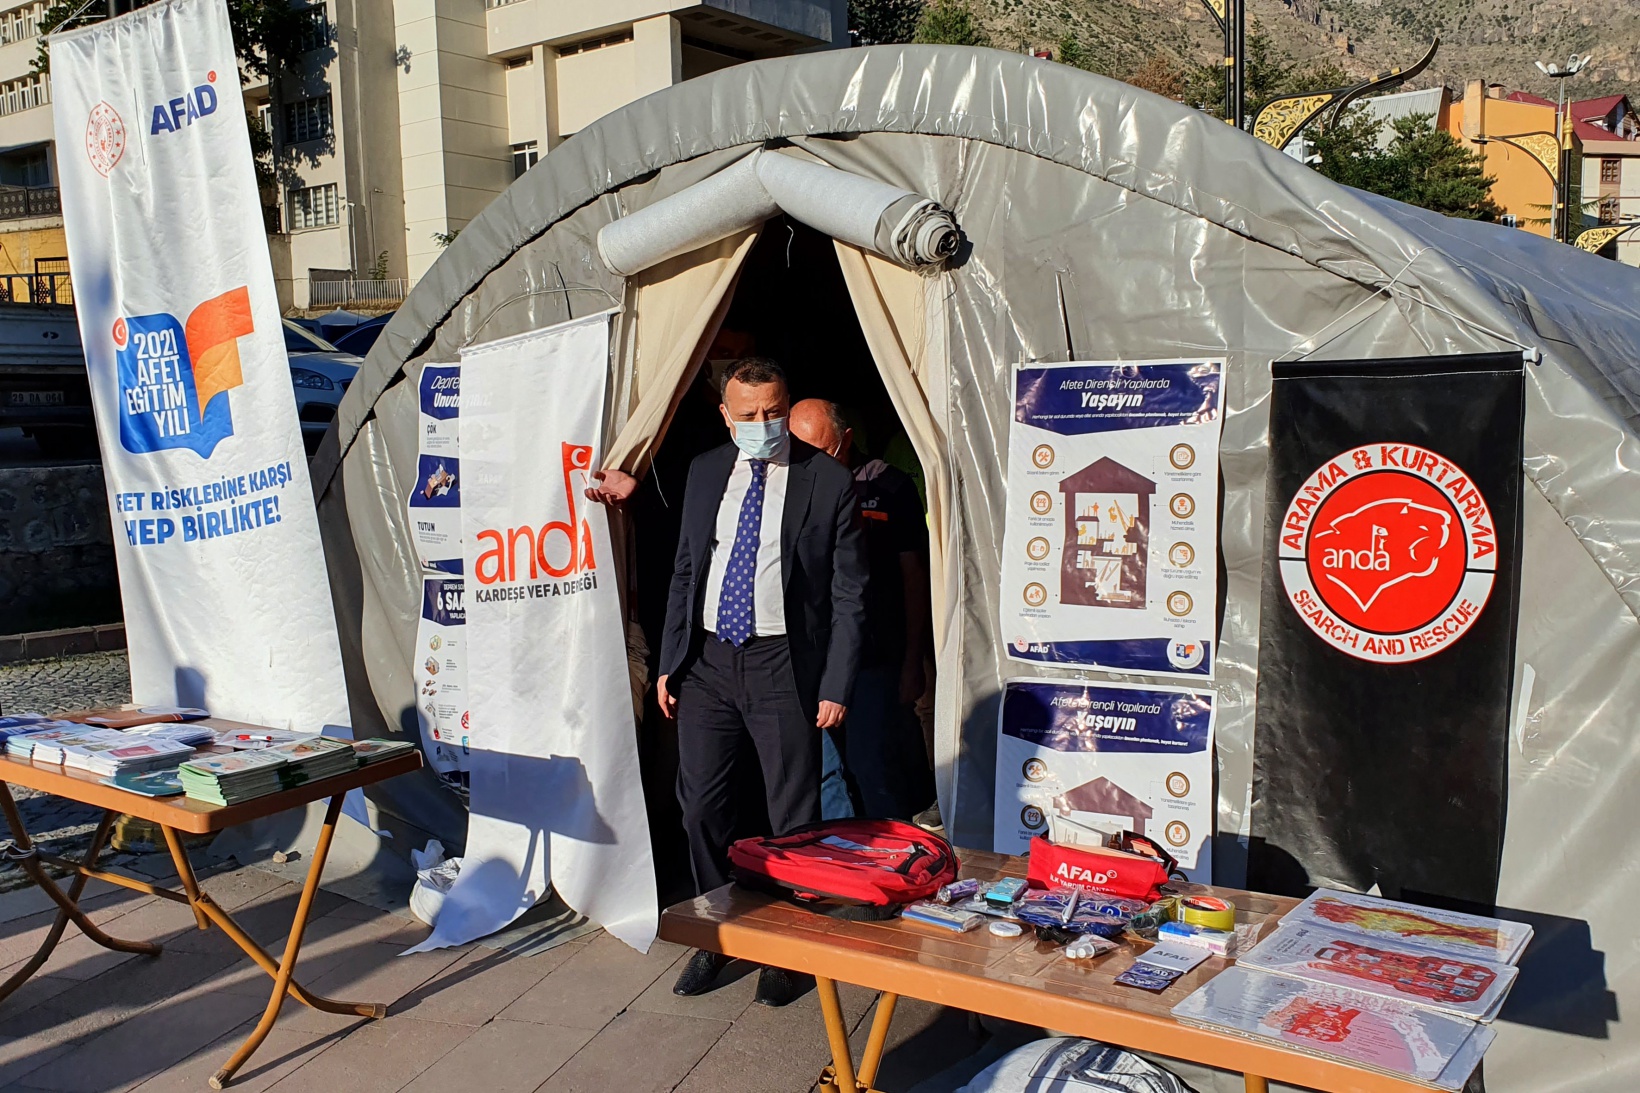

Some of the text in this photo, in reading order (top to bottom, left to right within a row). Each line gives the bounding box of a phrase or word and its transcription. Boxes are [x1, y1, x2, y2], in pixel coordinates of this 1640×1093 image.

[150, 84, 218, 136] AFAD
[133, 328, 179, 359] 2021
[137, 355, 181, 386] AFET
[430, 375, 460, 391] Depre
[1059, 378, 1171, 391] Afete Dirençli Yapılarda
[1081, 392, 1144, 411] Yaşayın
[152, 408, 190, 437] YILI
[151, 475, 247, 510] RİSKLERİNE
[248, 461, 292, 492] KARŞI
[1282, 446, 1496, 560] ARAMA & KURTARMA
[124, 495, 282, 547] HEP BİRLİKTE!
[417, 521, 436, 532] TUTUN
[1322, 524, 1391, 571] anda
[437, 592, 466, 611] 6 SAA
[475, 586, 525, 603] KARDEŞE
[527, 582, 561, 598] VEFA
[1293, 588, 1480, 656] SEARCH AND RESCUE
[1029, 645, 1049, 654] AFAD
[1116, 701, 1161, 715] Yapılarda
[1057, 862, 1108, 885] AFAD
[1152, 950, 1190, 961] AFAD
